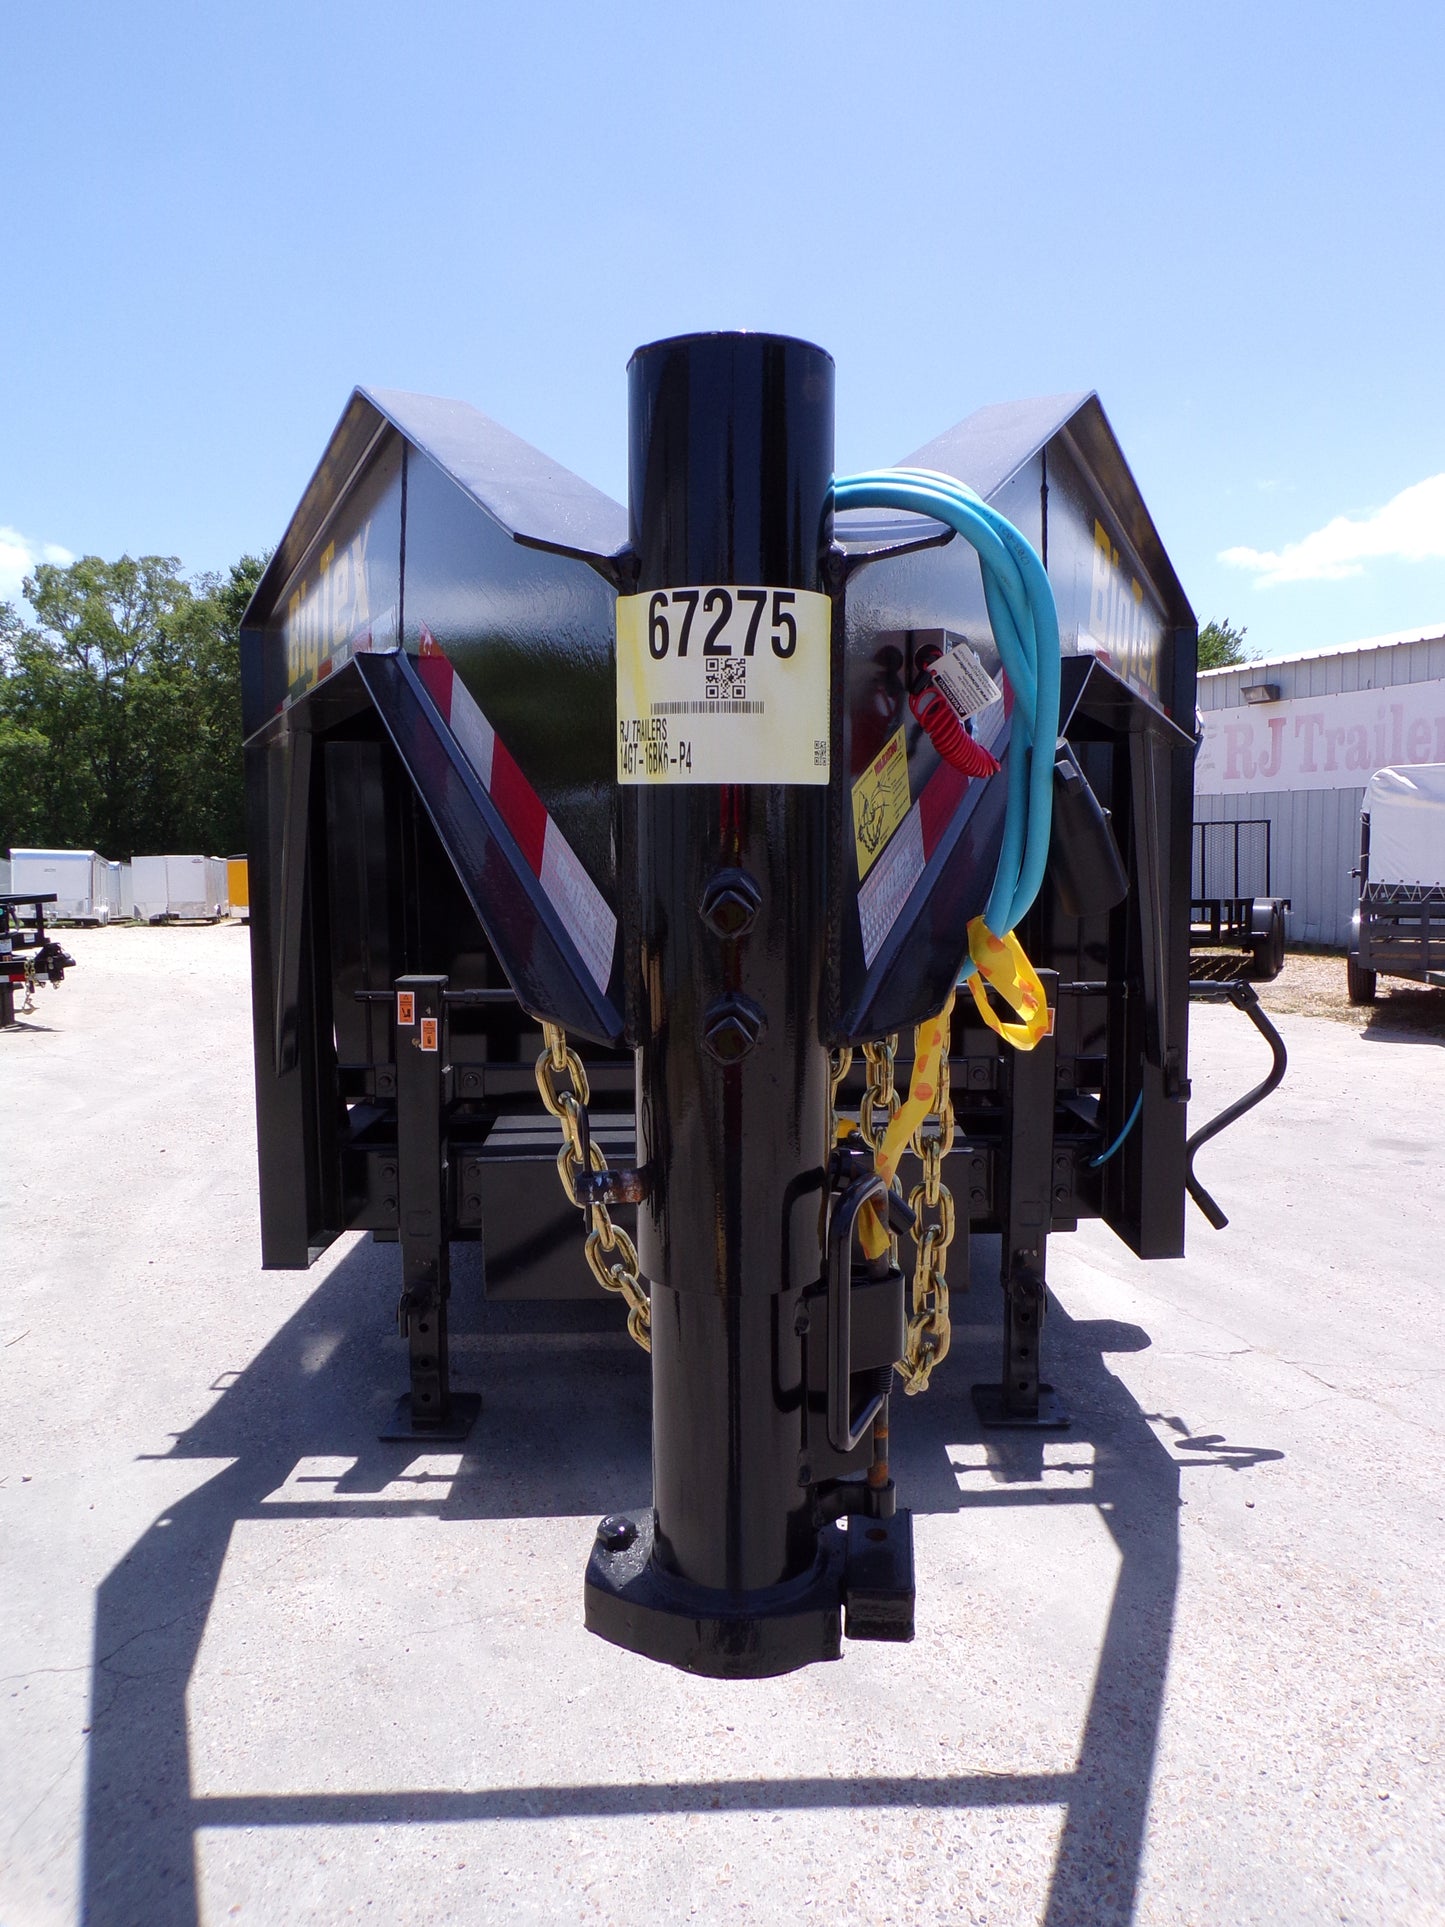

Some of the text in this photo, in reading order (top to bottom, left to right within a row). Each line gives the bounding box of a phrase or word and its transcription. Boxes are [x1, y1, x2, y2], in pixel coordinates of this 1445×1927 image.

[648, 588, 797, 660] 67275
[937, 678, 960, 709] WARNING
[620, 718, 667, 742] RJ TRAILERS
[1223, 717, 1287, 780] RJ
